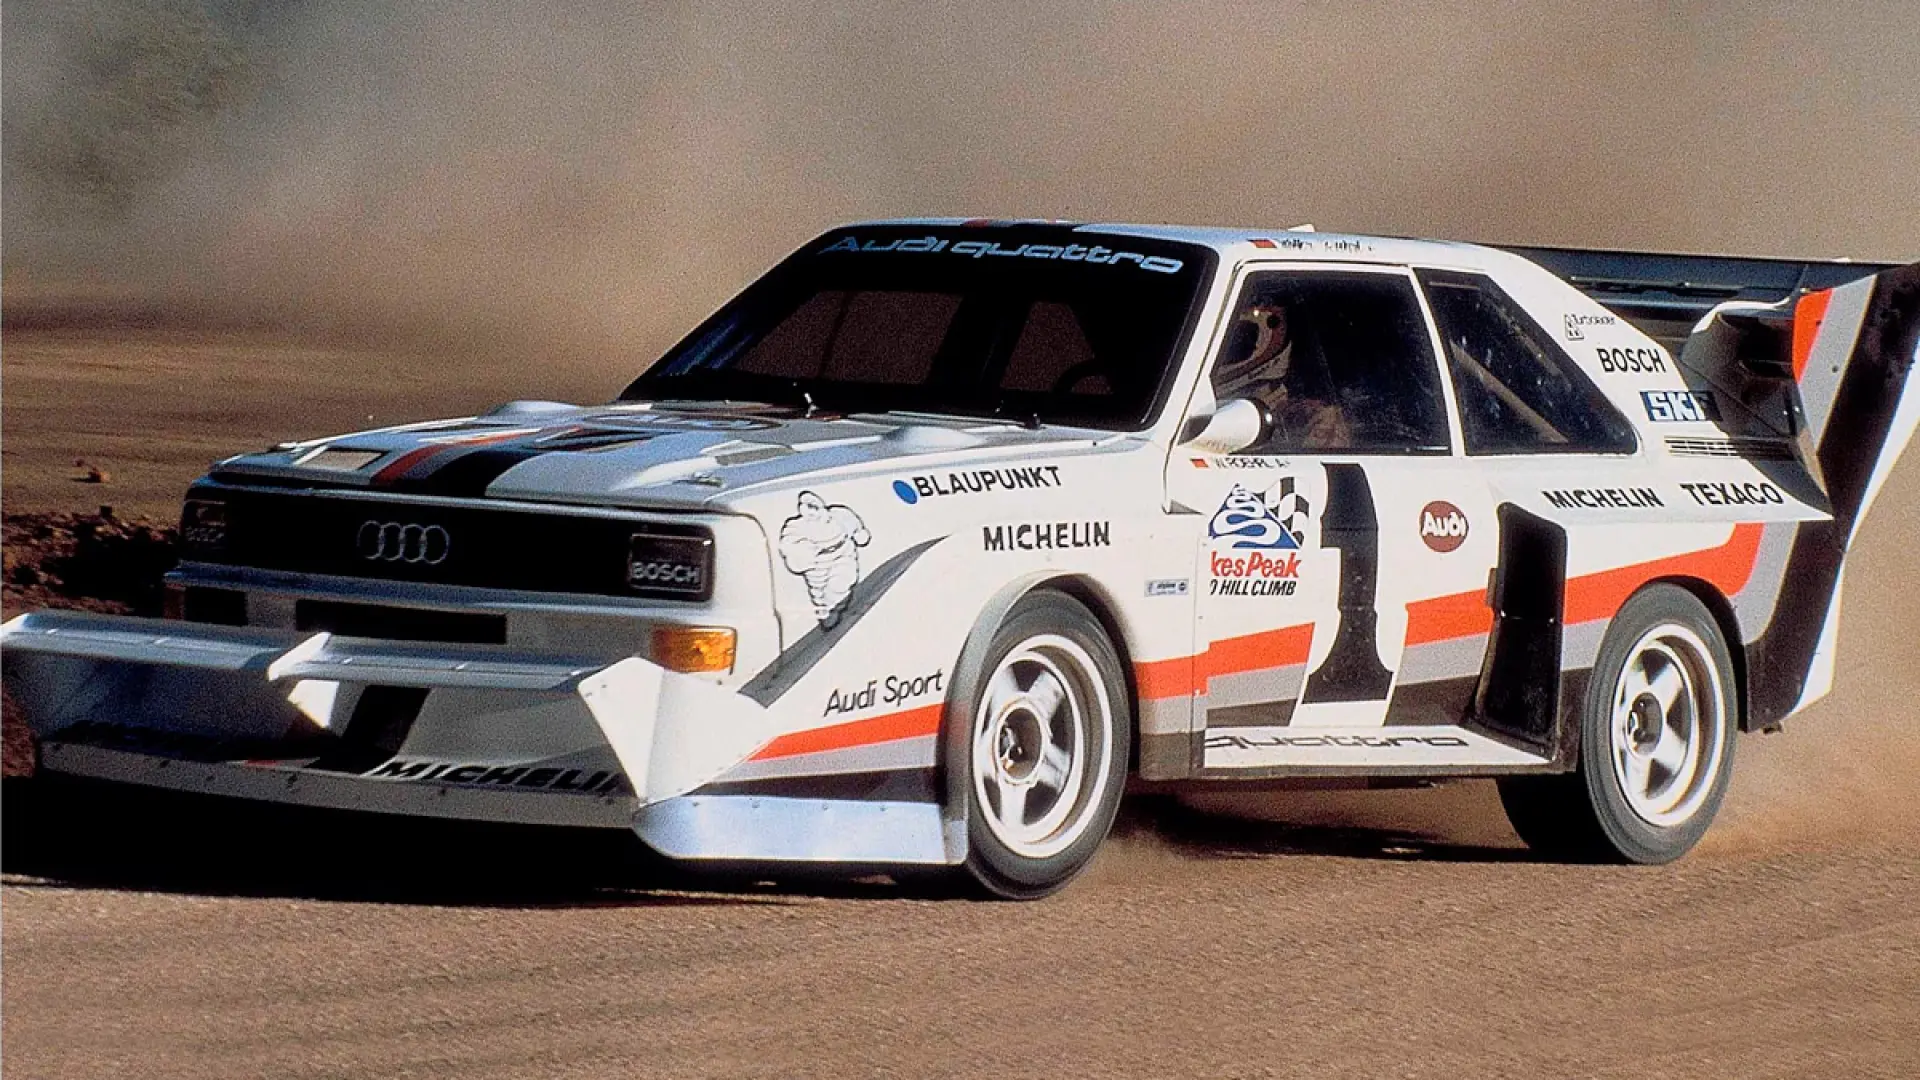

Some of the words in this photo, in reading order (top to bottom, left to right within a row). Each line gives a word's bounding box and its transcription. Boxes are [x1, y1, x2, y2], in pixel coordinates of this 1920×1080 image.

[818, 236, 949, 253] Audi
[951, 241, 1184, 274] quattro
[1597, 347, 1666, 373] BOSCH
[912, 466, 1062, 497] BLAUPUNKT
[1542, 486, 1665, 508] MICHELIN
[1680, 482, 1785, 505] TEXACO
[982, 521, 1111, 551] MICHELIN
[1421, 511, 1466, 538] Audi
[631, 562, 700, 584] BOSCH
[1246, 551, 1302, 578] Peak
[1218, 579, 1250, 596] HILL
[1250, 580, 1297, 597] CLIMB
[1302, 462, 1394, 704] 1
[823, 679, 878, 717] Audi
[882, 668, 943, 708] Sport
